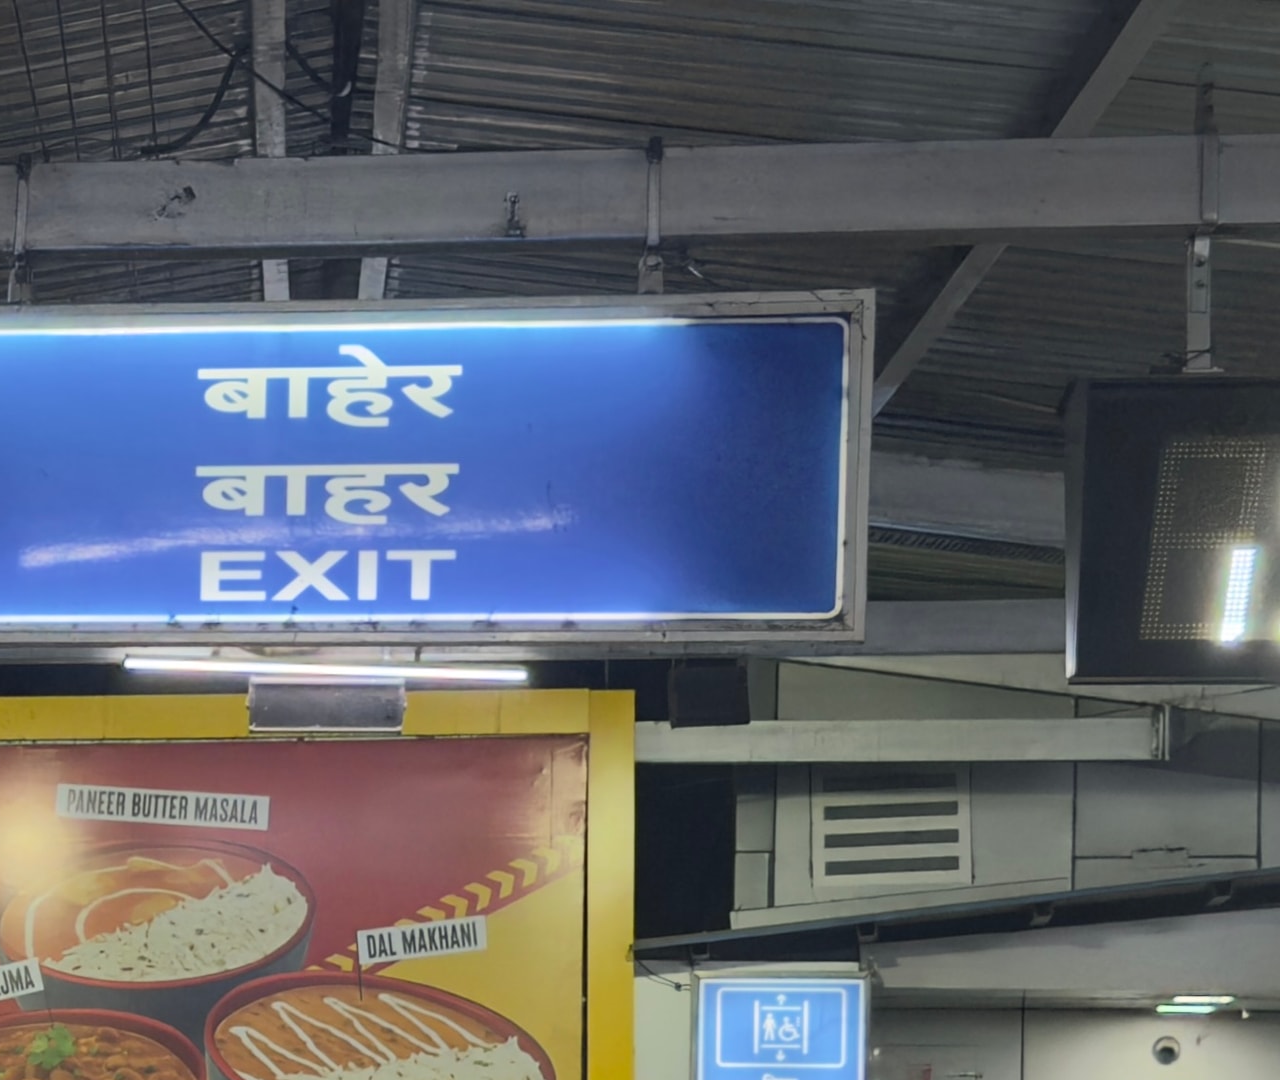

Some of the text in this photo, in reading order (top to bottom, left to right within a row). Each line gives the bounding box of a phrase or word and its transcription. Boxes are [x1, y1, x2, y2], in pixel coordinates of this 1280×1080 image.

[197, 344, 463, 428] बाहेर
[195, 461, 461, 526] बाहर
[200, 549, 456, 603] EXIT
[66, 788, 260, 825] PANEER BUTTER MASALA
[366, 921, 479, 960] DAL MAKHANI
